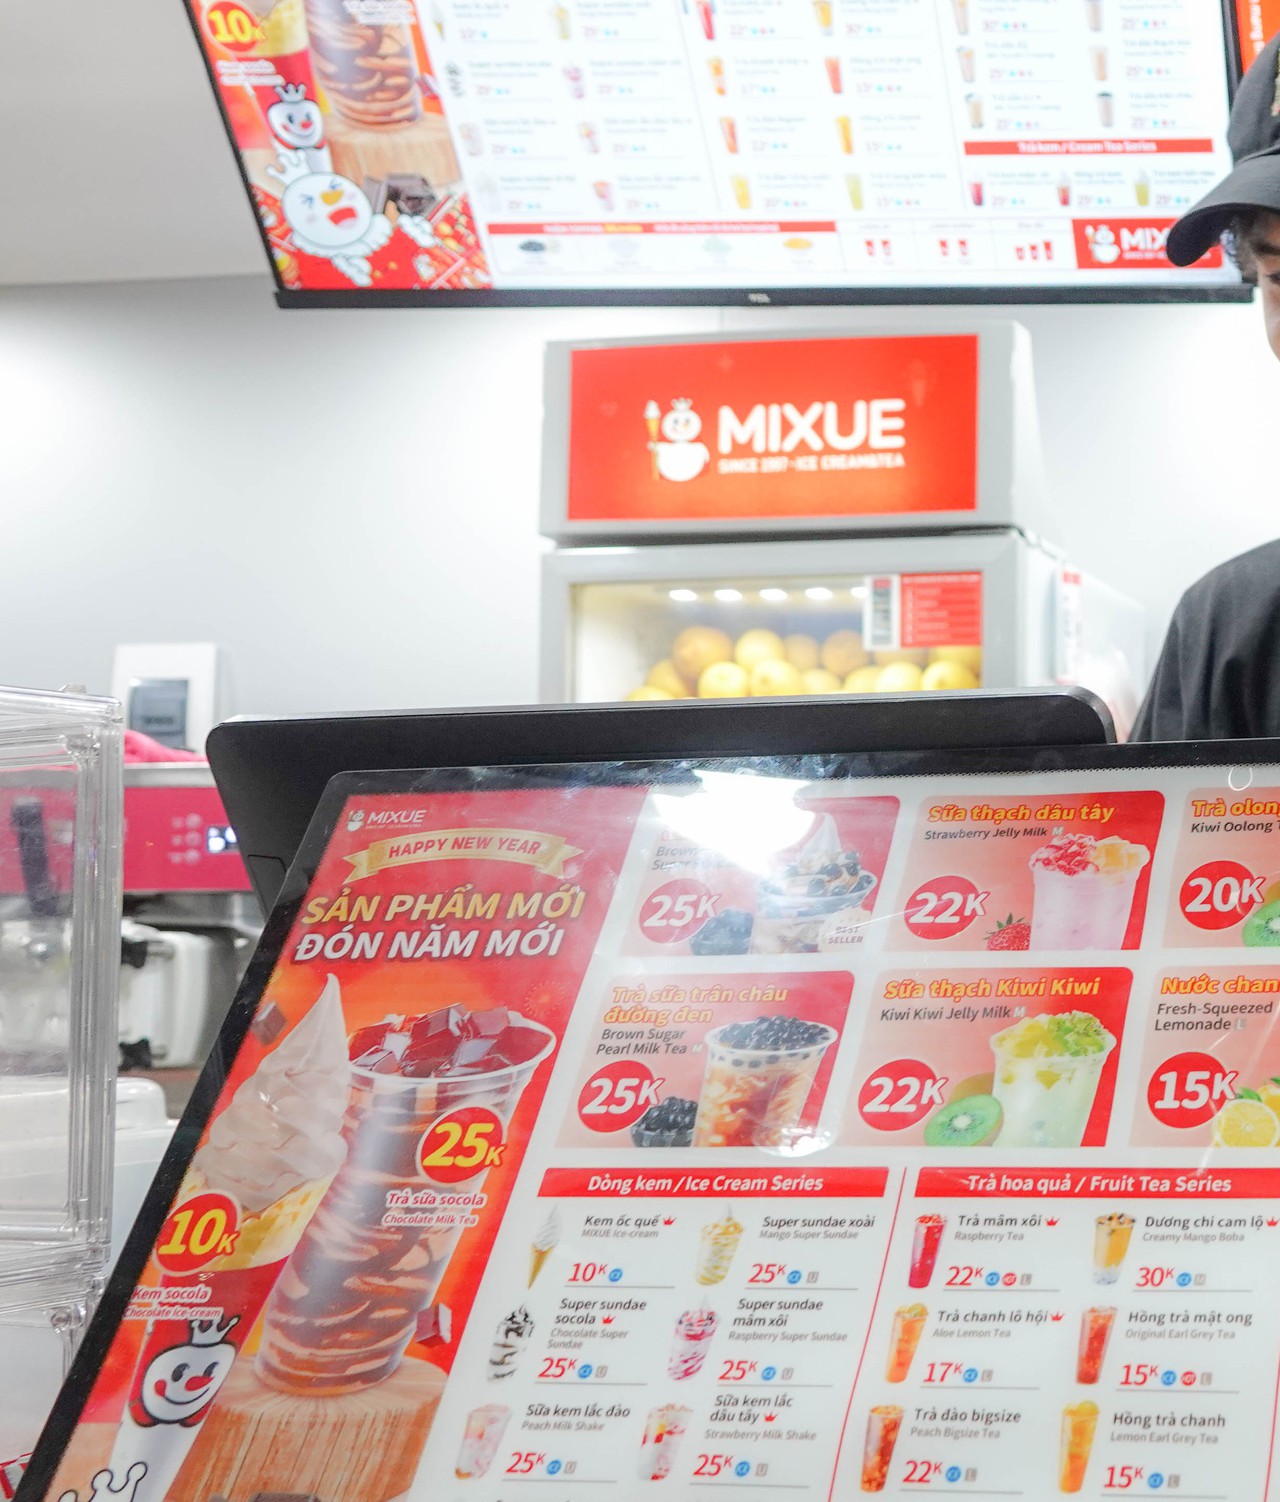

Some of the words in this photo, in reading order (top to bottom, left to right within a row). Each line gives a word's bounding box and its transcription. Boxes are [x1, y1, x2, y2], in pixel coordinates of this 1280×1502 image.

[717, 398, 906, 454] MIXUE
[367, 810, 427, 824] MIXUE
[927, 804, 968, 823] Sữa
[970, 804, 1032, 826] thạch
[1034, 804, 1075, 821] dâu
[1079, 802, 1116, 823] tây
[1191, 799, 1228, 818] Trà
[924, 828, 991, 841] Strawberry
[992, 828, 1021, 840] Jelly
[1022, 827, 1047, 838] Milk
[1190, 822, 1221, 833] Kiwi
[1223, 820, 1273, 834] Oolong
[388, 838, 449, 859] HAPPY
[452, 836, 492, 851] NEW
[497, 837, 542, 855] YEAR
[301, 887, 382, 924] SẢN
[384, 883, 500, 922] PHẨM
[506, 882, 587, 920] MỚI
[1184, 876, 1266, 913] 20K
[642, 893, 722, 928] 25K
[908, 891, 990, 925] 22K
[294, 924, 385, 962] ĐÓN
[387, 924, 481, 960] NĂM
[483, 920, 565, 958] MỚI
[828, 935, 864, 945] SELLER
[612, 984, 645, 1003] Trà
[649, 985, 685, 1003] sữa
[689, 985, 735, 1003] trân
[737, 986, 789, 1003] châu
[884, 980, 924, 999] Sữa
[930, 979, 993, 1003] thạch
[996, 977, 1047, 997] Kiwi
[1050, 976, 1101, 996] Kiwi
[1160, 974, 1219, 995] Nước
[603, 1005, 669, 1027] đường
[672, 1007, 714, 1023] đen
[880, 1008, 910, 1021] Kiwi
[913, 1008, 943, 1020] Kiwi
[946, 1007, 979, 1022] Jelly
[982, 1006, 1011, 1019] Milk
[1157, 1002, 1273, 1016] Fresh-Squeezed
[1155, 1018, 1232, 1031] Lemonade
[601, 1028, 644, 1040] Brown
[647, 1028, 687, 1043] Sugar
[596, 1044, 631, 1055] Pearl
[633, 1042, 660, 1054] Milk
[663, 1044, 687, 1055] Tea
[581, 1077, 664, 1115] 25K
[862, 1076, 948, 1113] 22K
[1154, 1070, 1239, 1110] 15K
[422, 1122, 506, 1167] 25K
[588, 1174, 633, 1195] Dòng
[635, 1174, 670, 1191] kem
[684, 1176, 710, 1191] Ice
[712, 1175, 768, 1191] Cream
[771, 1174, 824, 1191] Series
[967, 1175, 996, 1191] Trà
[1000, 1175, 1034, 1192] hoa
[1037, 1173, 1072, 1195] quả
[1090, 1175, 1135, 1192] Fruit
[1139, 1176, 1171, 1192] Tea
[1175, 1175, 1232, 1192] Series
[387, 1191, 413, 1206] Trà
[414, 1189, 437, 1206] sữa
[438, 1192, 484, 1207] socola
[383, 1213, 433, 1225] Chocolate
[435, 1213, 456, 1224] Milk
[458, 1214, 478, 1225] Tea
[584, 1216, 613, 1227] Kem
[617, 1214, 632, 1227] ốc
[635, 1213, 659, 1230] quế
[763, 1217, 800, 1230] Super
[801, 1216, 846, 1227] sundae
[849, 1216, 875, 1227] xoài
[958, 1214, 981, 1226] Trà
[984, 1214, 1019, 1226] mâm
[1021, 1215, 1043, 1227] xôi
[158, 1209, 238, 1256] 10K
[954, 1232, 1004, 1243] Raspberry
[1007, 1231, 1024, 1241] Tea
[567, 1262, 607, 1283] 10K
[946, 1266, 984, 1286] 22K
[133, 1287, 162, 1300] Kem
[165, 1286, 208, 1300] socola
[124, 1307, 171, 1318] Chocolate
[173, 1307, 222, 1318] Ice-cream
[1129, 1311, 1164, 1326] Hồng
[1169, 1311, 1191, 1323] trà
[1195, 1311, 1222, 1325] mật
[1226, 1313, 1253, 1326] ong
